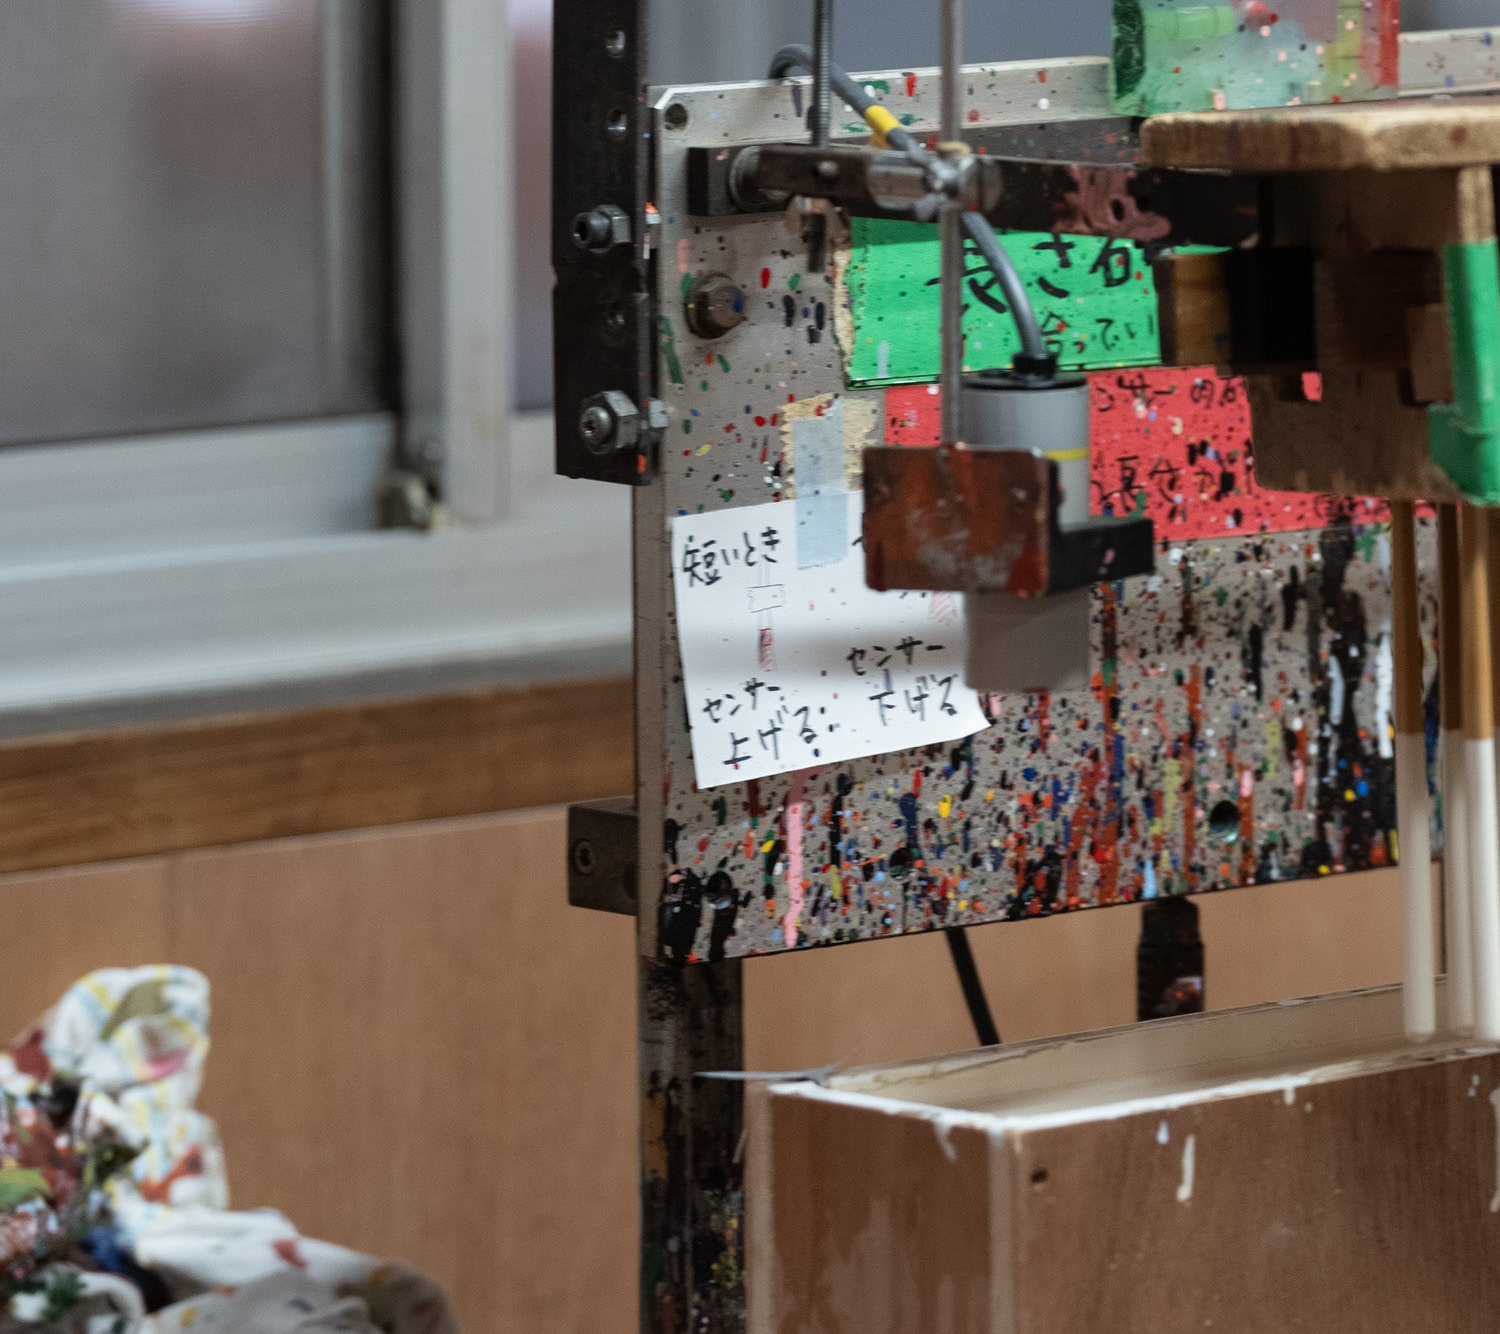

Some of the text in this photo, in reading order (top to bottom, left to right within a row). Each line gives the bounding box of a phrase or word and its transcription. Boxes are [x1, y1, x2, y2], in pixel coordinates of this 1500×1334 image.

[682, 527, 780, 587] 短いとき
[845, 636, 944, 676] センサー
[702, 677, 781, 724] センサー
[868, 673, 959, 727] 下げる
[723, 704, 818, 765] 上げる
